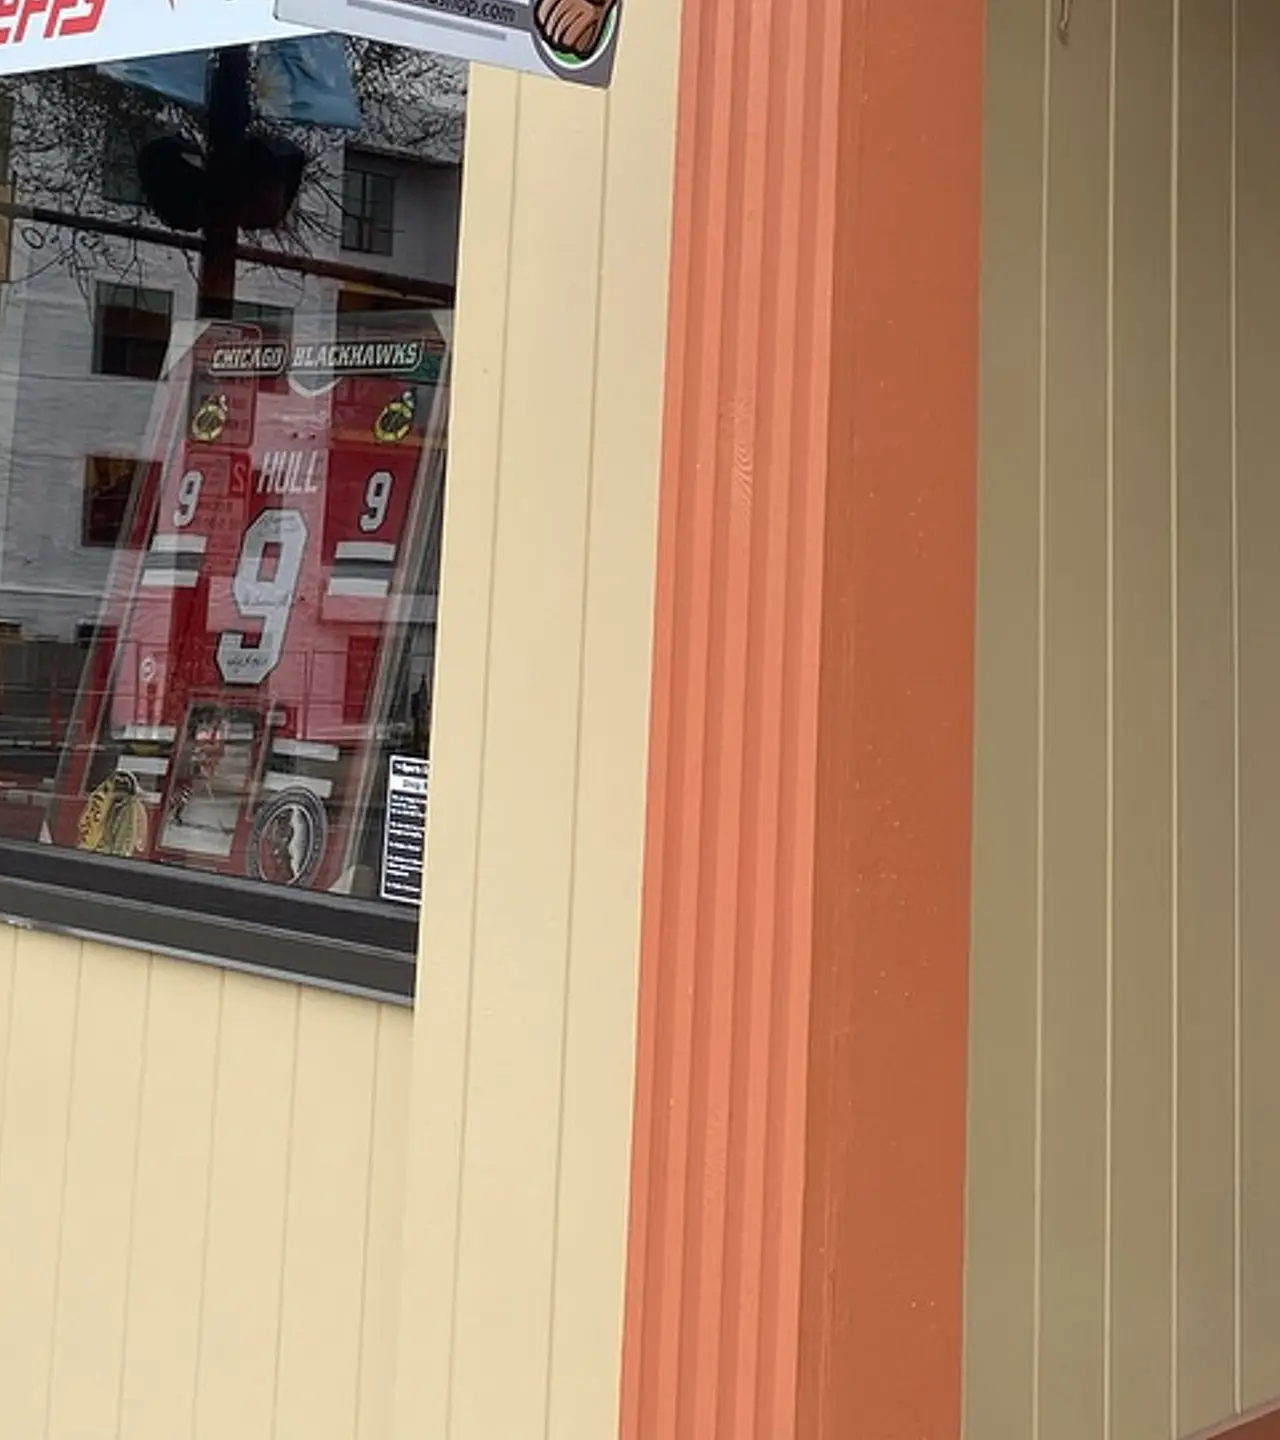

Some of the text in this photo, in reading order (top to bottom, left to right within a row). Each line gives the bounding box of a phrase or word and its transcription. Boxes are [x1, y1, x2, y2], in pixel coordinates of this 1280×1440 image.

[212, 343, 418, 368] CHICAGO BLACKHAWKS
[172, 470, 203, 528] 9
[256, 450, 319, 494] HULL
[359, 470, 394, 533] 9
[215, 510, 310, 686] 9
